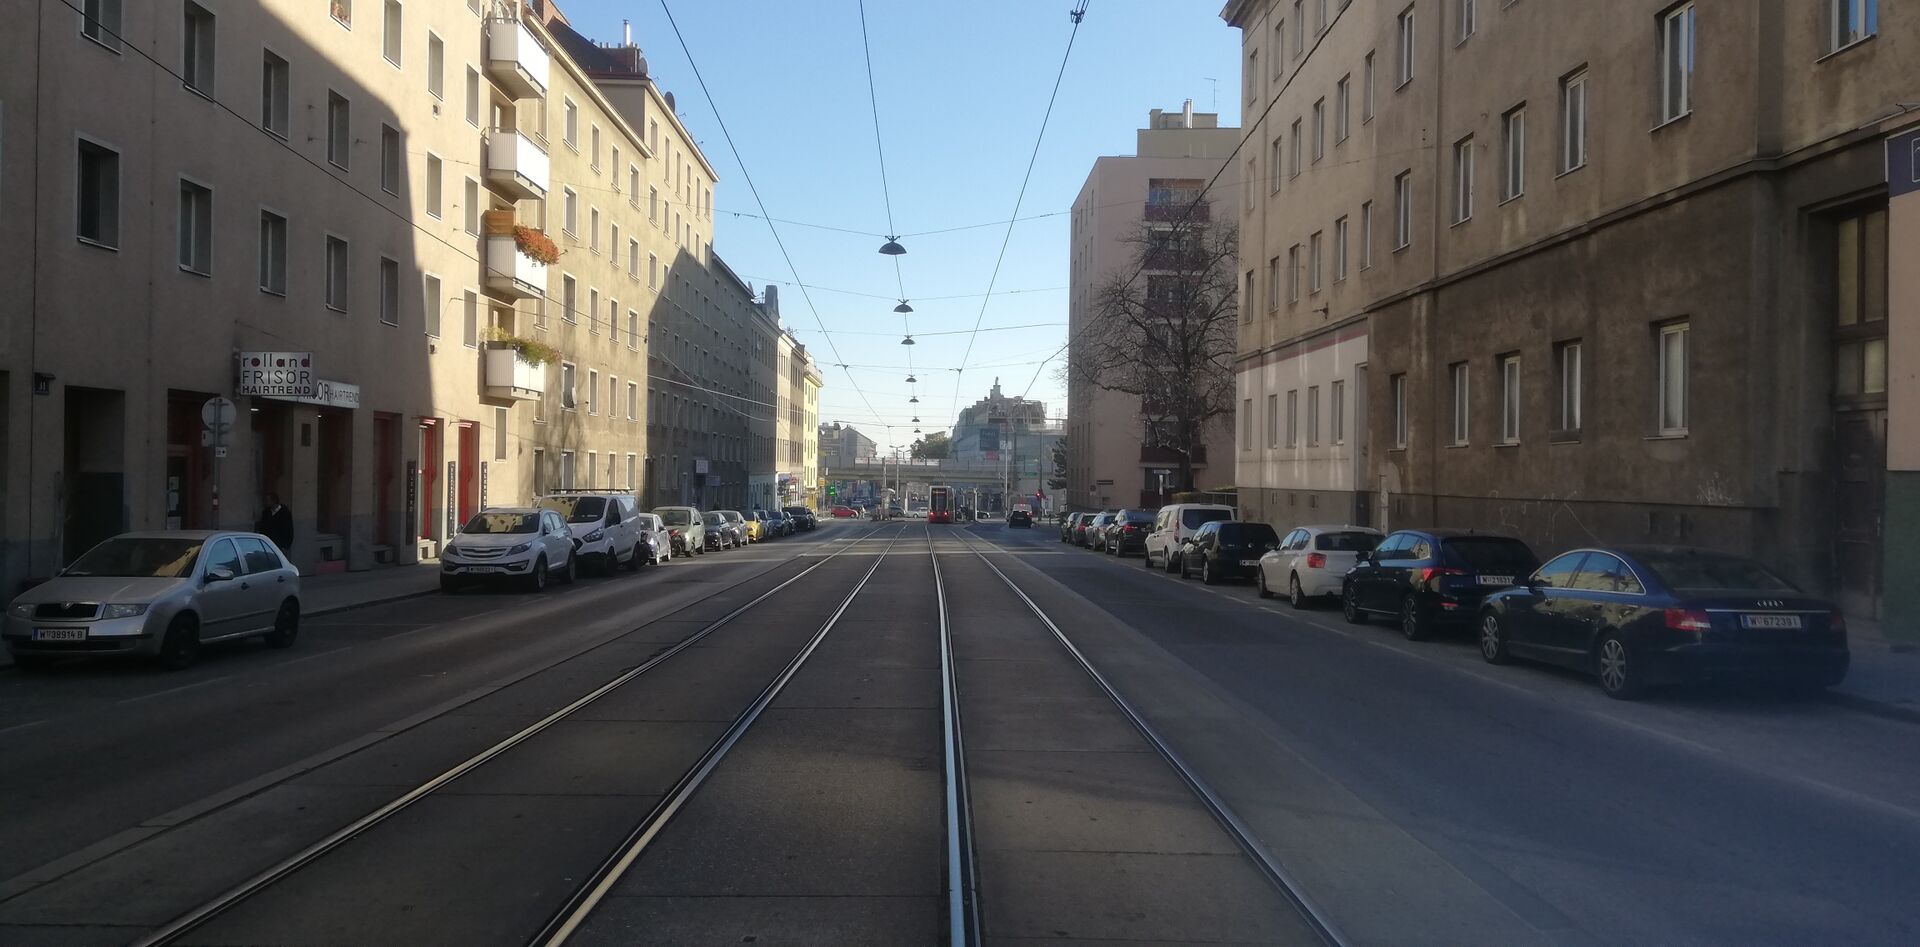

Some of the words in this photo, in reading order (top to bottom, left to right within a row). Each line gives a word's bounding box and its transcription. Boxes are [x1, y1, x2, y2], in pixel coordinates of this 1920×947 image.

[242, 353, 311, 368] rolland
[242, 369, 311, 385] FRISÖR
[242, 385, 311, 395] HAIRTREND
[330, 390, 359, 403] HAIRTREND
